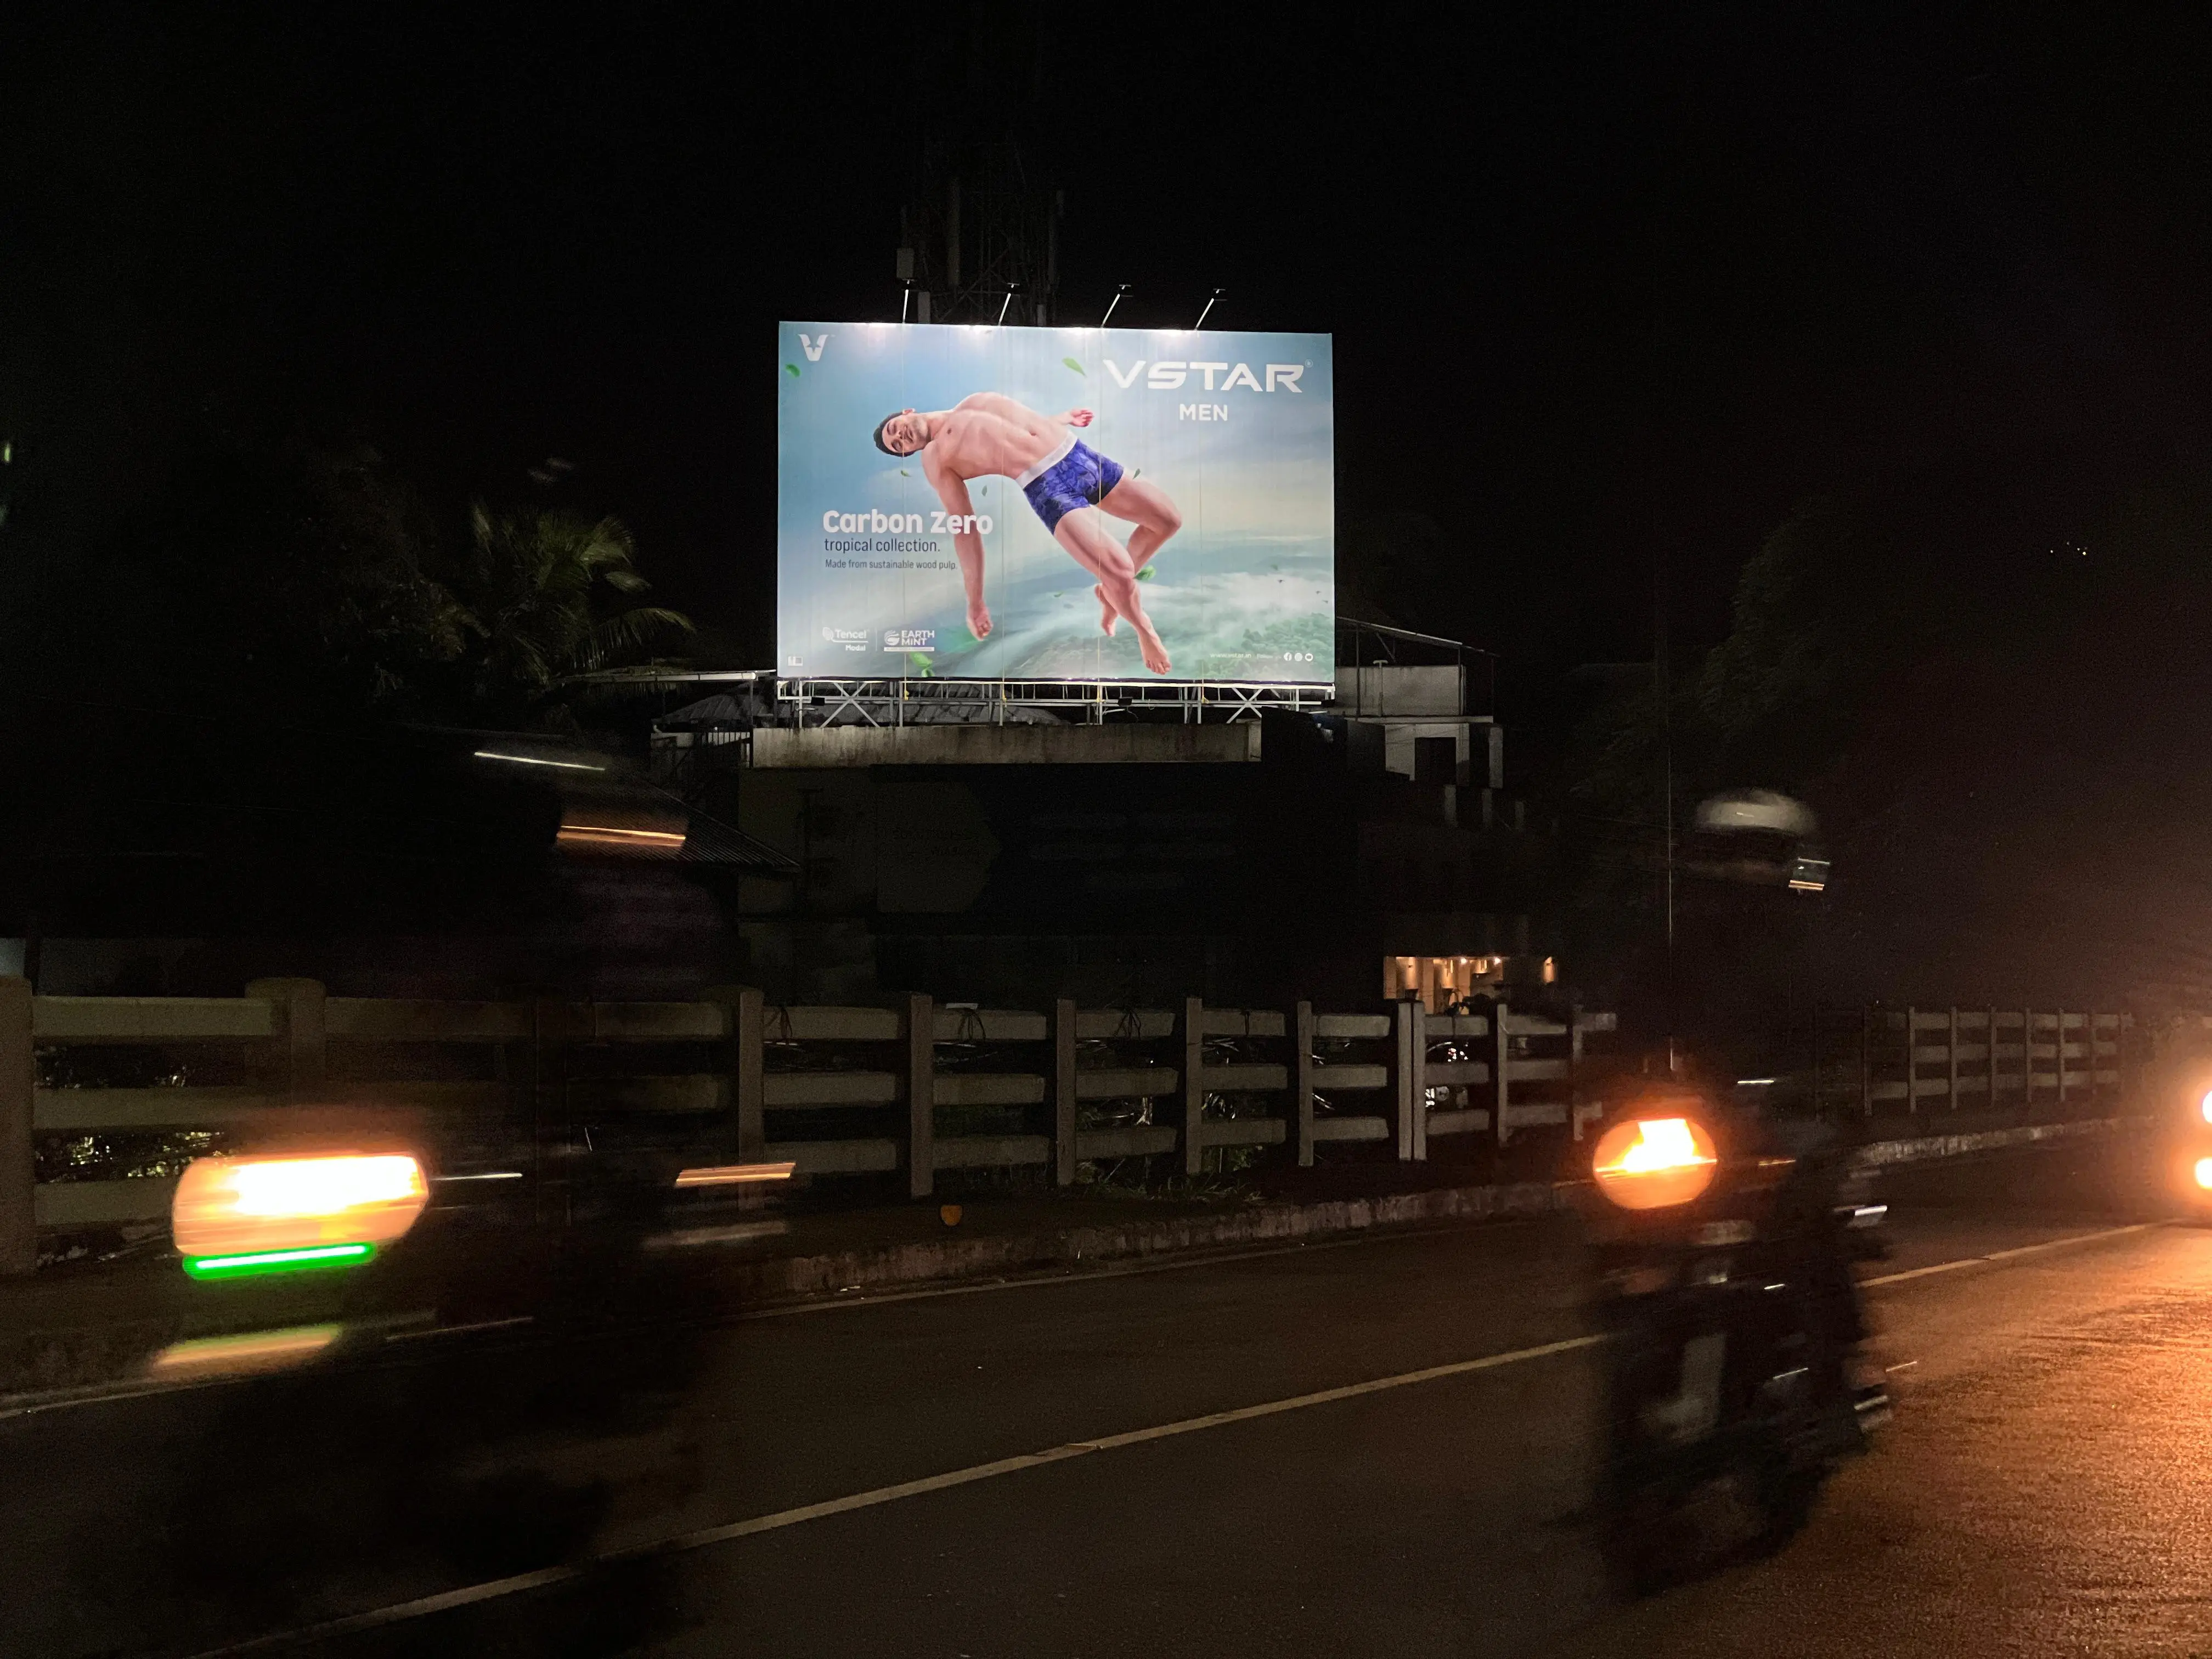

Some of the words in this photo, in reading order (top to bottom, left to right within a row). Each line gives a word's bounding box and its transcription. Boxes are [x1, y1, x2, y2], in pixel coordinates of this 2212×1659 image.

[1103, 359, 1304, 393] VSTAR
[1179, 404, 1228, 421] MEN
[823, 509, 923, 534] Carbon
[930, 511, 993, 534] Zero
[825, 538, 872, 554] tropical
[876, 538, 940, 552] collection.
[825, 559, 847, 568] Made
[848, 560, 867, 568] from
[869, 560, 914, 569] sustainable
[916, 560, 938, 569] wood
[833, 629, 867, 639] Tencel
[901, 630, 935, 638] EARTH
[901, 637, 927, 646] MINT
